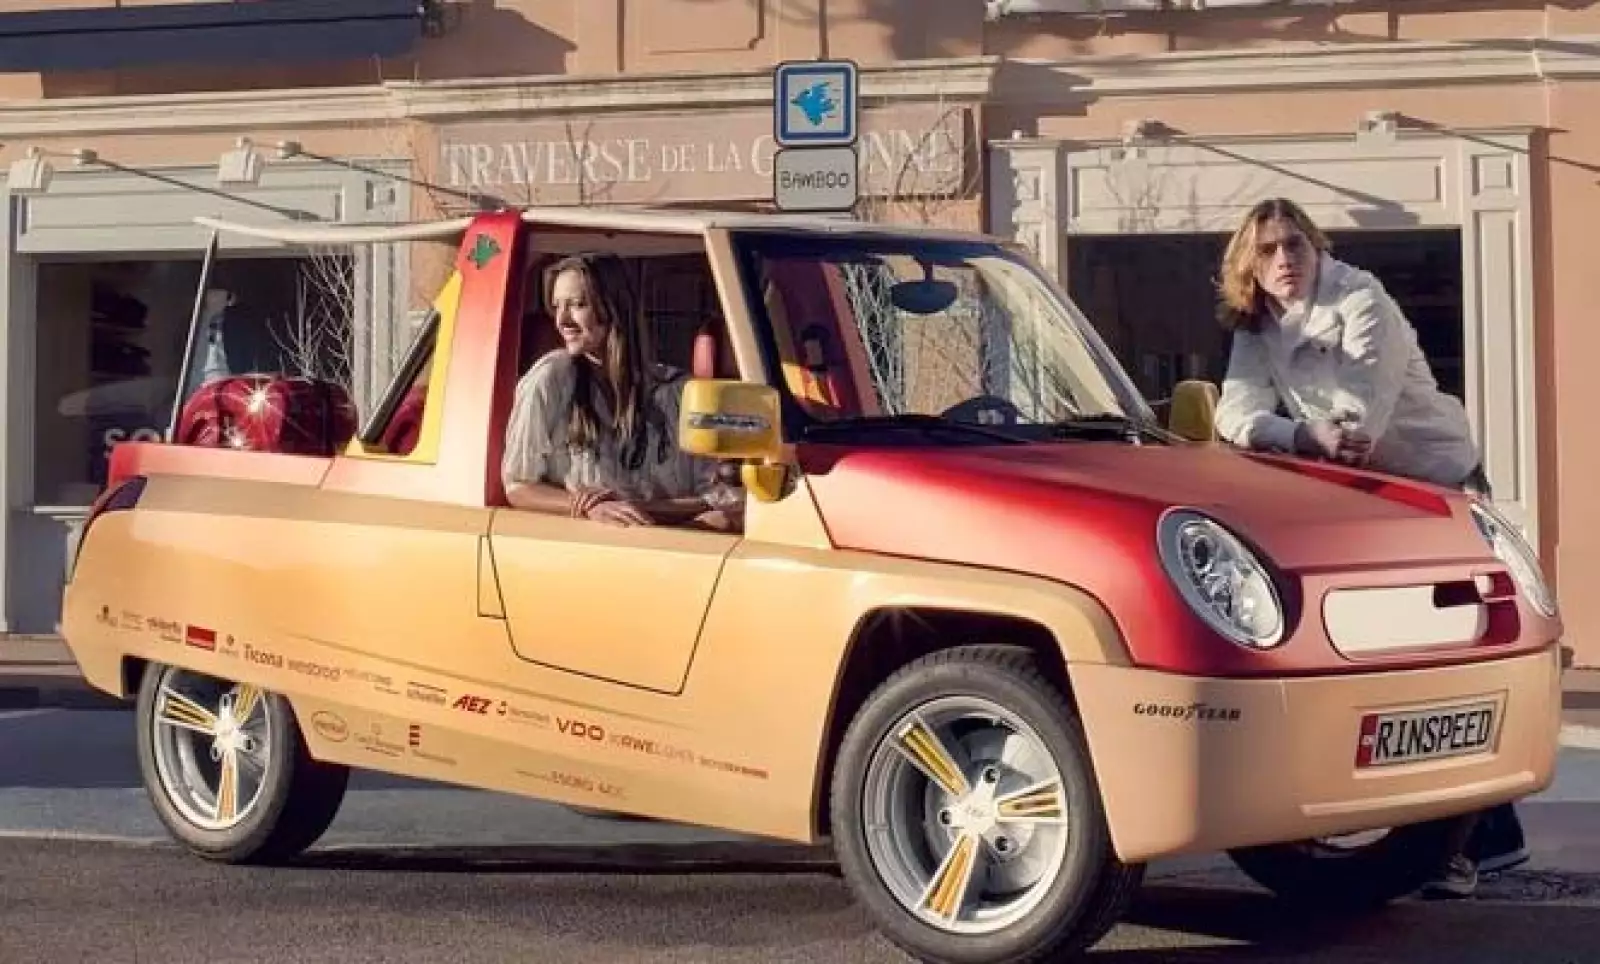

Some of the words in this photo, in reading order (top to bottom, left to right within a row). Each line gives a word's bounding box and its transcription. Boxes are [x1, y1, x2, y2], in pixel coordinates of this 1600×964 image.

[442, 138, 651, 187] TRAVERSE
[661, 144, 695, 172] DE
[707, 141, 743, 173] LA
[751, 129, 953, 177] GNNE
[780, 171, 850, 189] BAMBOO
[453, 694, 492, 715] AEZ
[1133, 702, 1241, 721] GOODYEAR
[556, 717, 605, 741] VDO
[1375, 709, 1493, 759] RINSPEED
